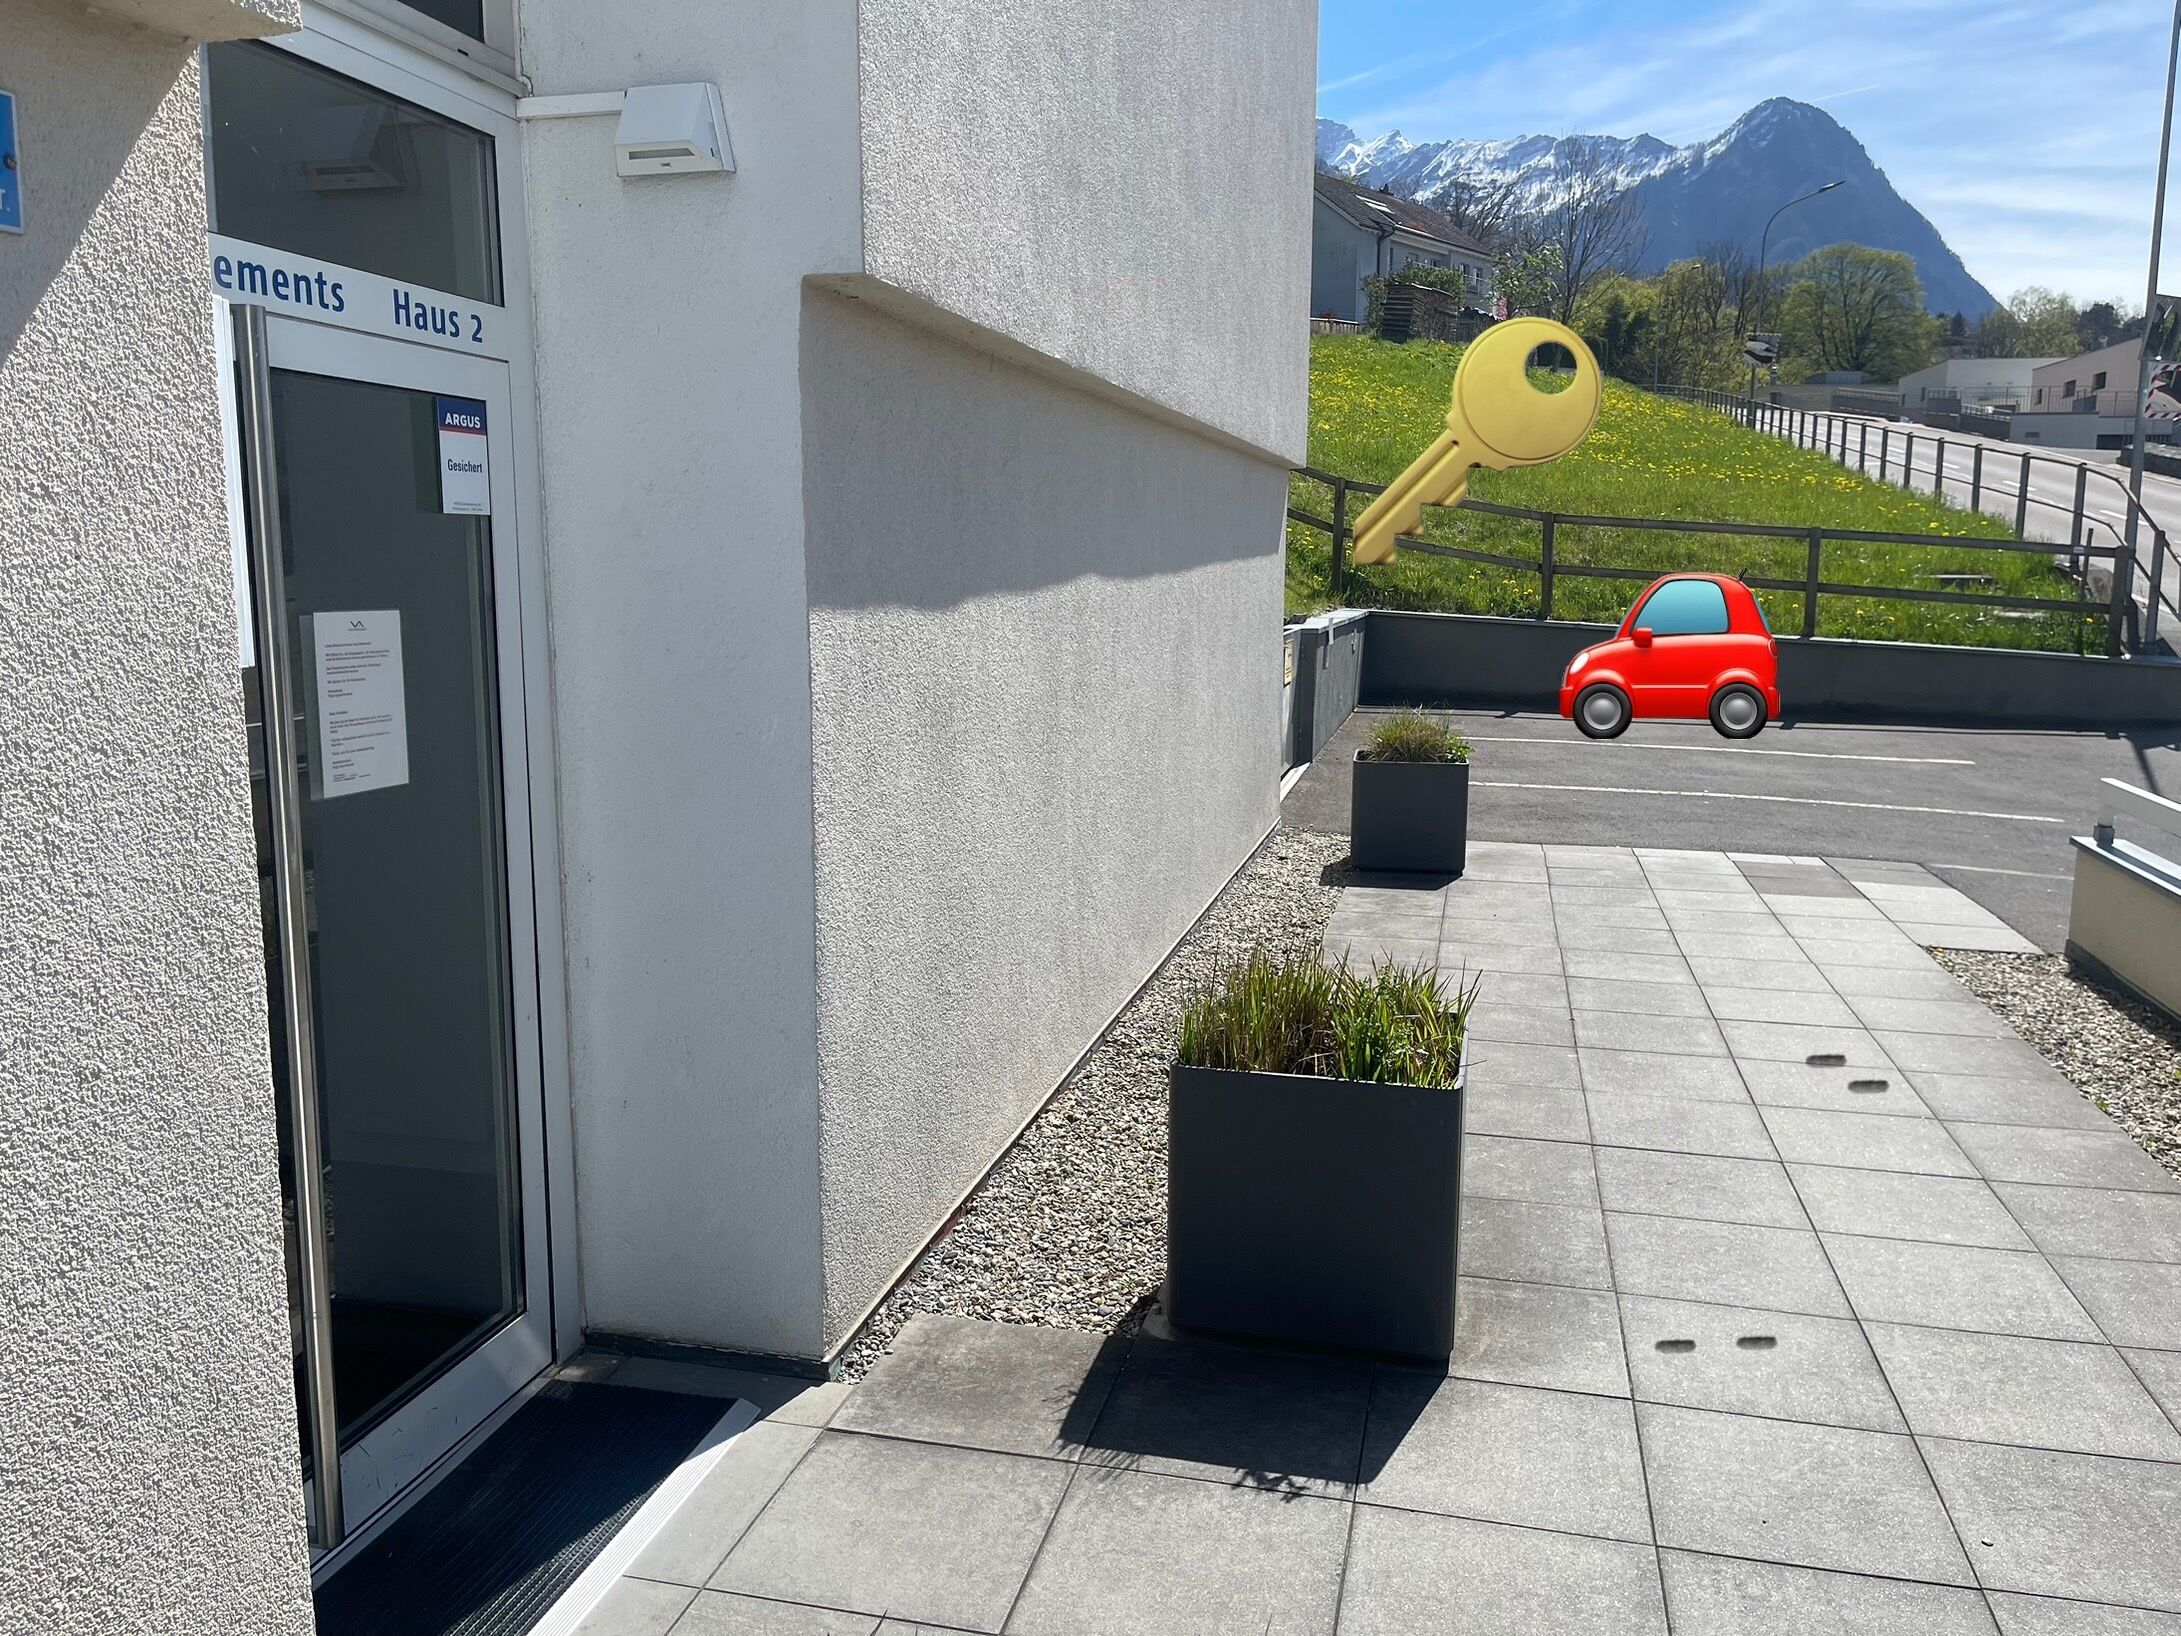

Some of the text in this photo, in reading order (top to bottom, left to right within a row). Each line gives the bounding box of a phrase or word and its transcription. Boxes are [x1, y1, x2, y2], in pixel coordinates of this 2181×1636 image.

[393, 288, 460, 338] Haus
[470, 313, 483, 344] 2
[445, 412, 481, 429] ARGUS
[447, 458, 483, 474] Gesichert
